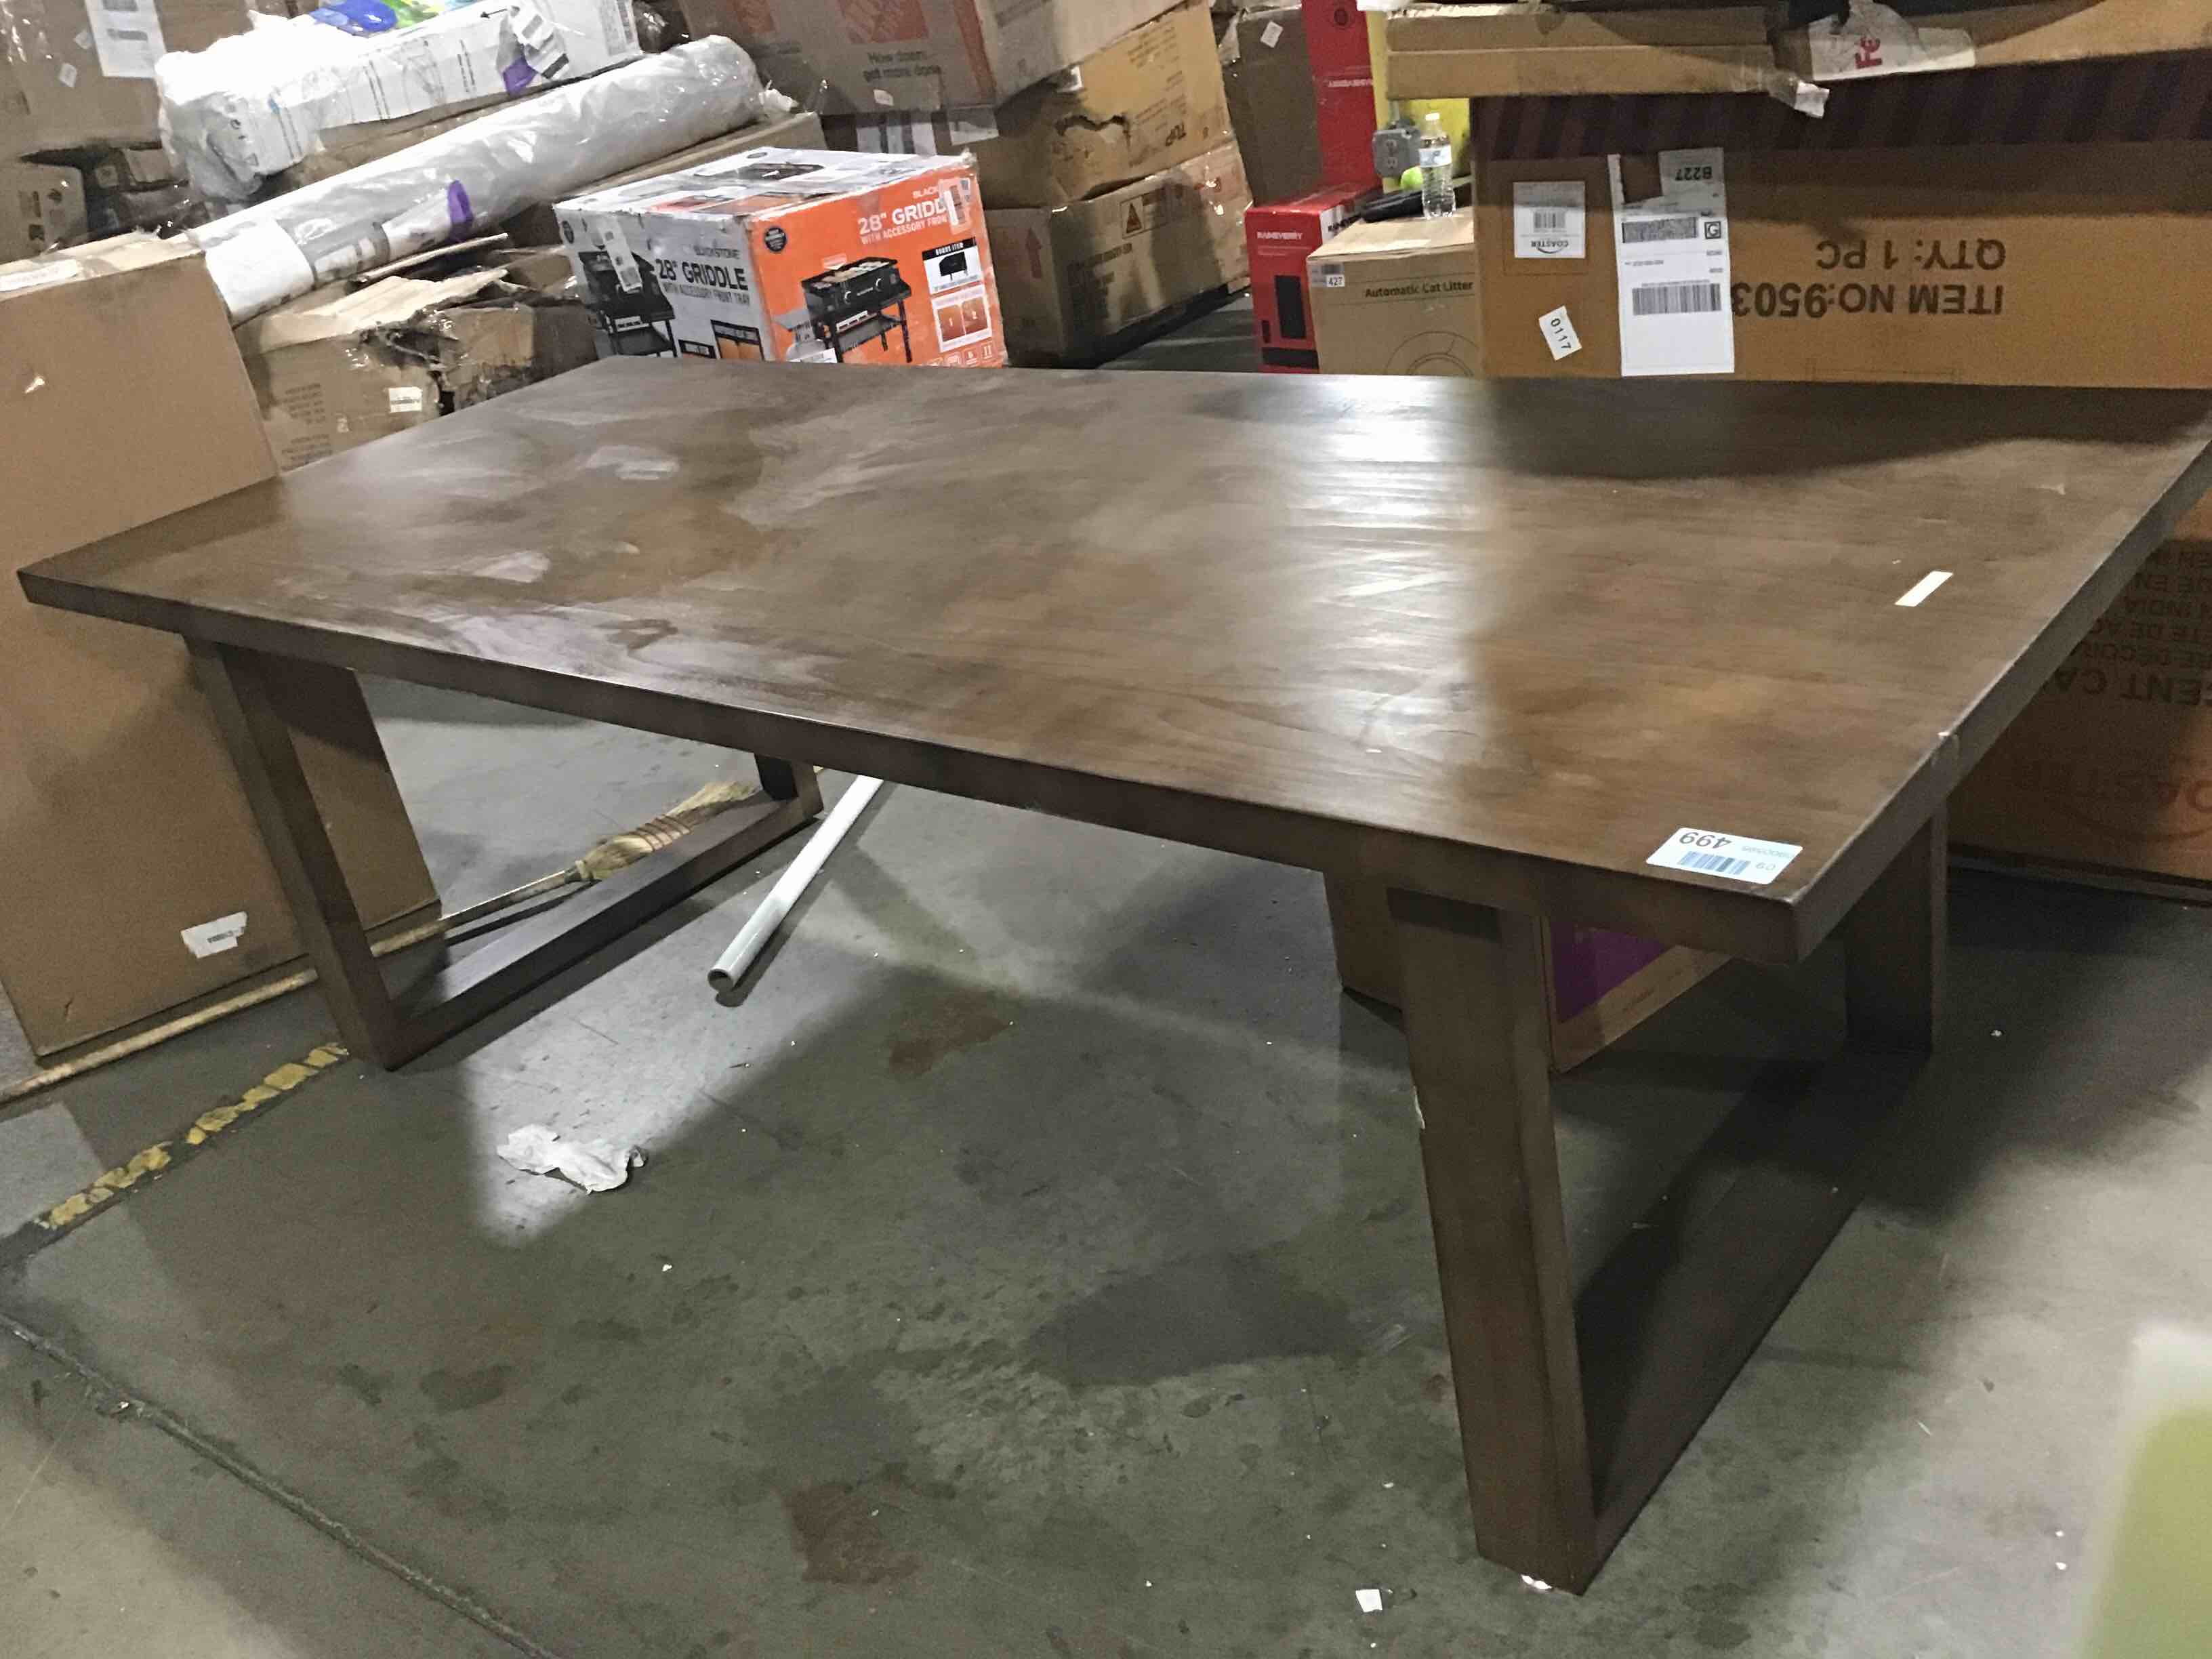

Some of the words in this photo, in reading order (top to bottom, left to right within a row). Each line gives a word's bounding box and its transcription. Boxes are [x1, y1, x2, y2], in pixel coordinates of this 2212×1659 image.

[1675, 166, 1713, 181] B227
[912, 186, 939, 199] BLACK
[891, 197, 948, 225] GRIDD
[883, 220, 926, 239] ACCESSORY
[927, 213, 948, 226] FRON
[1530, 240, 1570, 248] COASTER
[1816, 239, 1867, 270] PC
[1885, 239, 1899, 270] 1
[1914, 239, 2007, 270] QTY:
[682, 262, 749, 291] GRIDDLE
[1328, 276, 1343, 286] 427
[1365, 285, 1420, 298] Automatic
[1424, 283, 1441, 294] Cat
[1444, 280, 1474, 293] Litter
[1908, 284, 2005, 315] ITEM
[1550, 318, 1572, 349] 0117
[1679, 831, 1732, 849] 499
